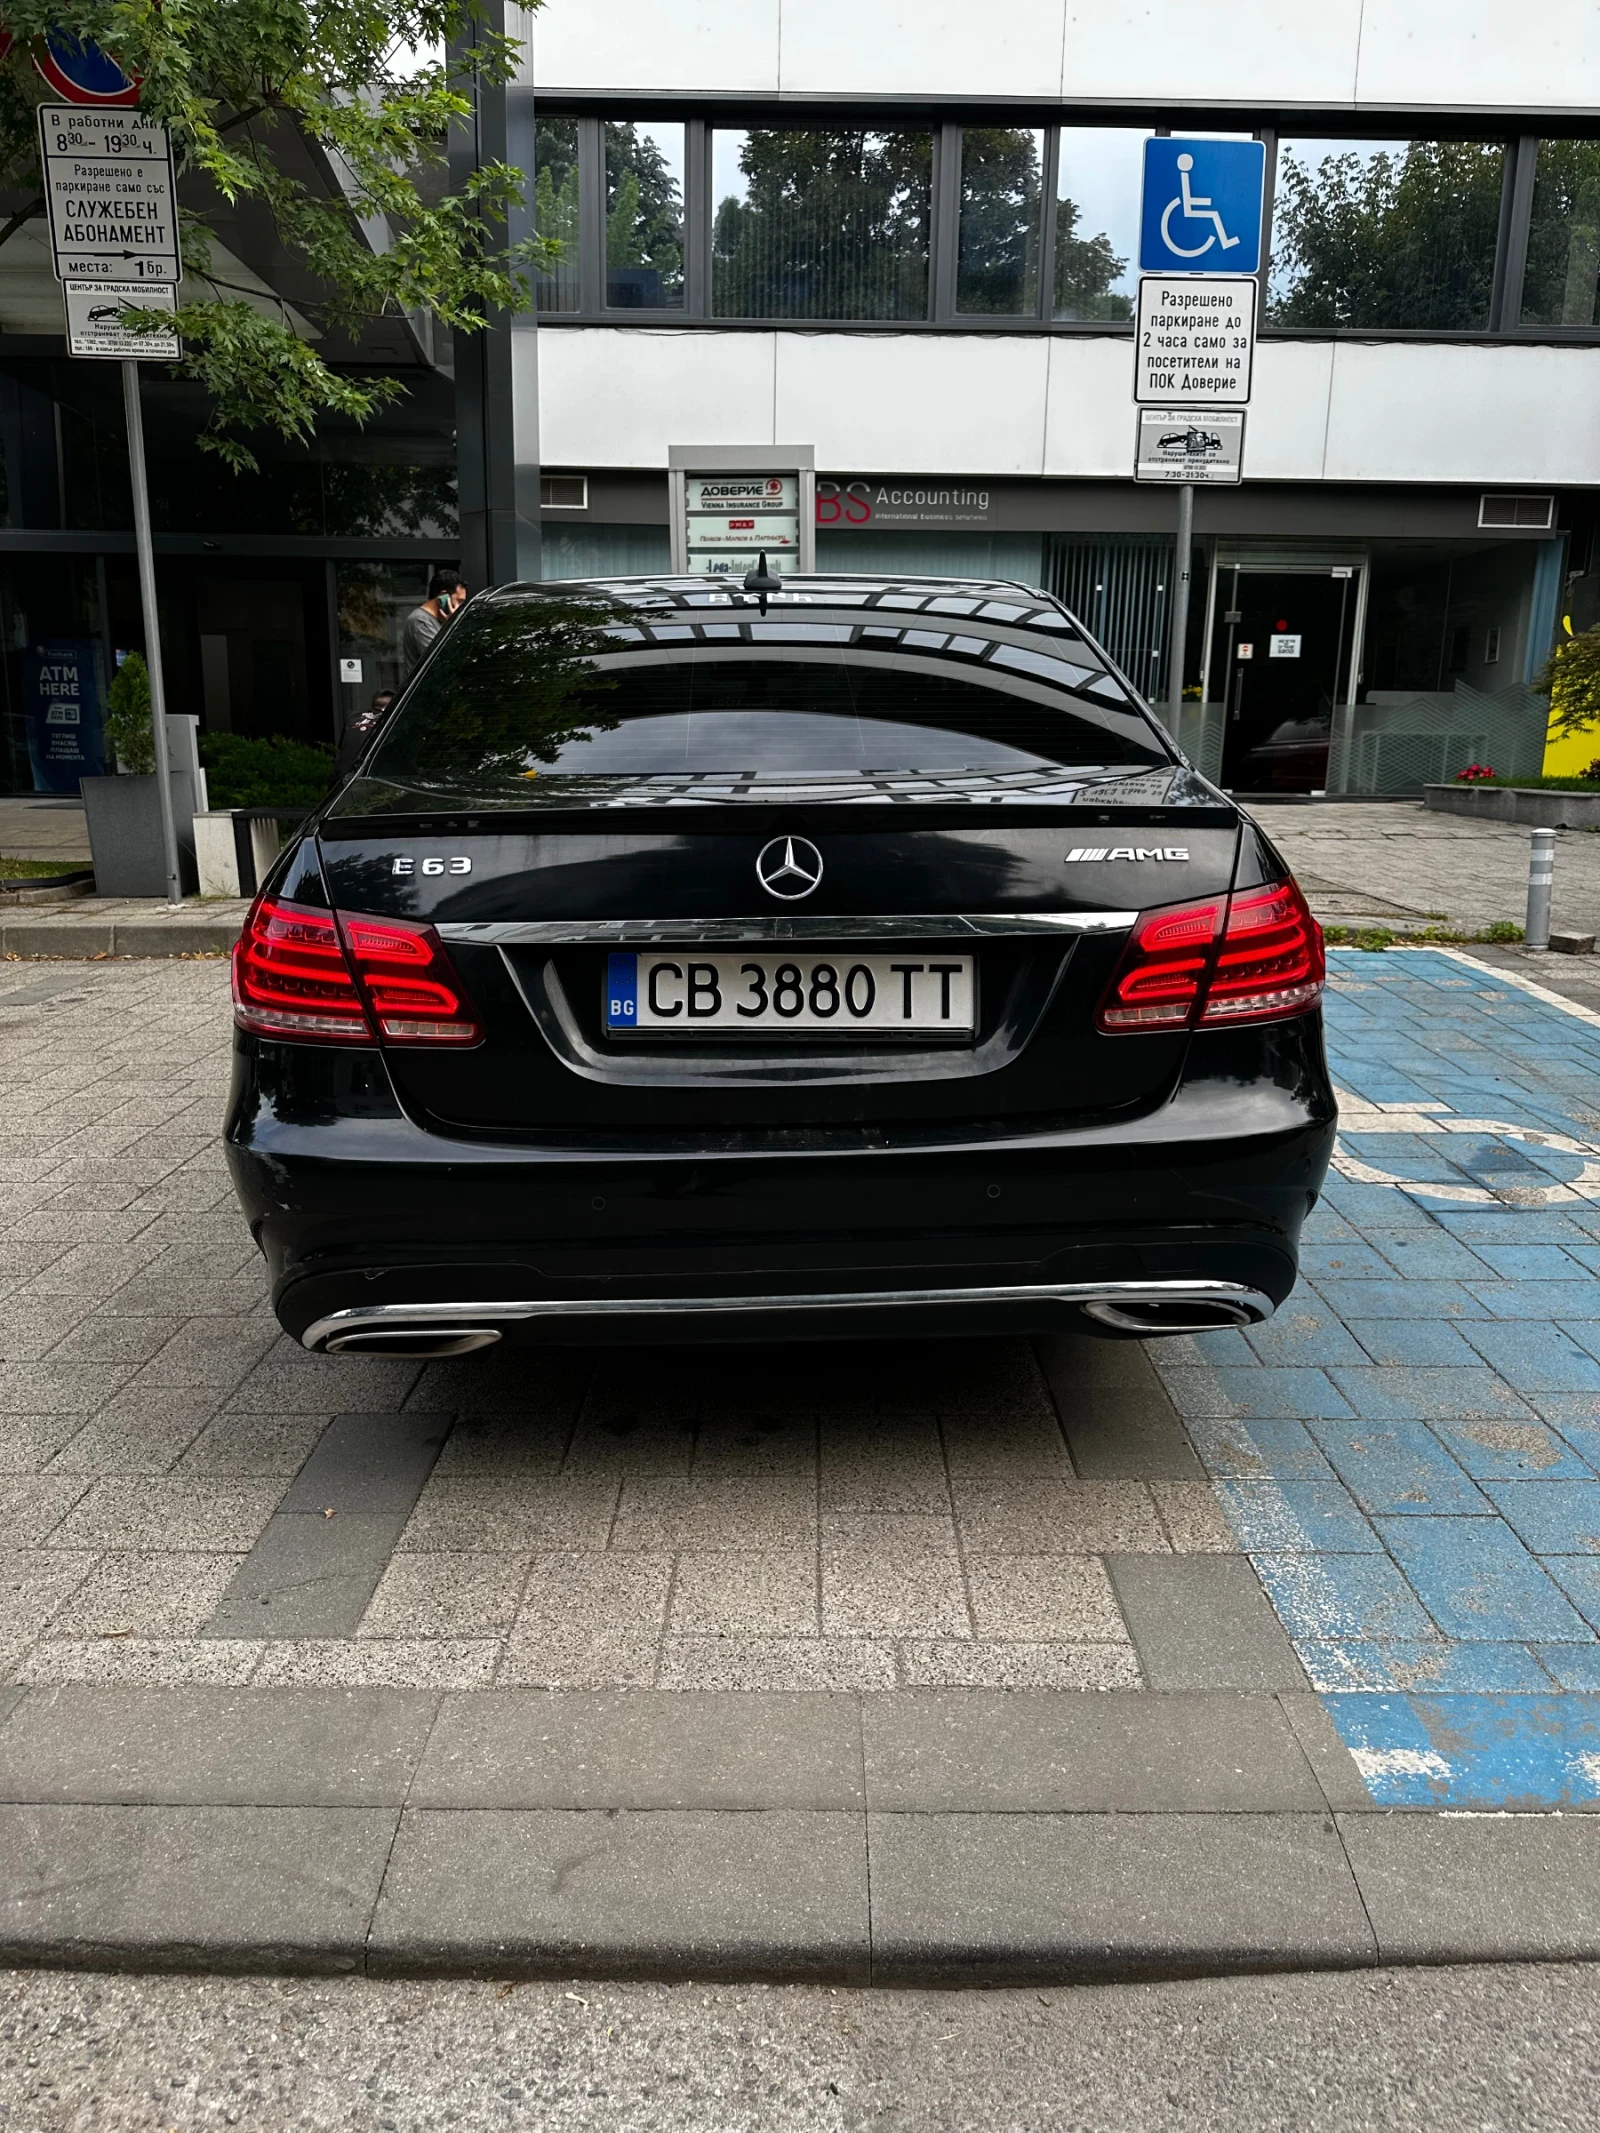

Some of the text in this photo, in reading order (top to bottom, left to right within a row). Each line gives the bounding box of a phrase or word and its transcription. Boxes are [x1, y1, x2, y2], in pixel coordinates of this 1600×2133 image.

[51, 114, 60, 126] В
[68, 116, 124, 130] работни
[74, 164, 143, 180] Разрешено е
[56, 181, 165, 194] паркиране само със
[66, 200, 158, 220] СЛУЖЕБЕН
[64, 224, 165, 244] АБОНАМЕНТ
[69, 262, 113, 274] места:
[70, 283, 169, 294] ЦЕНТЪР ЗА ГРАДСКА МОБИЛНОСТ
[1162, 291, 1233, 310] Разрешено
[1151, 315, 1241, 331] паркиране до
[1144, 332, 1247, 348] 2 часа само за
[1147, 357, 1240, 368] посетители на
[1150, 373, 1236, 392] ПОК Доверие
[701, 486, 764, 497] ДОВЕРИЕ
[876, 487, 989, 510] Accounting
[39, 666, 78, 682] ATM
[39, 683, 80, 696] HERE
[1106, 848, 1190, 862] AMG
[648, 962, 963, 1019] CB 3880 TT
[611, 1000, 634, 1016] BG
